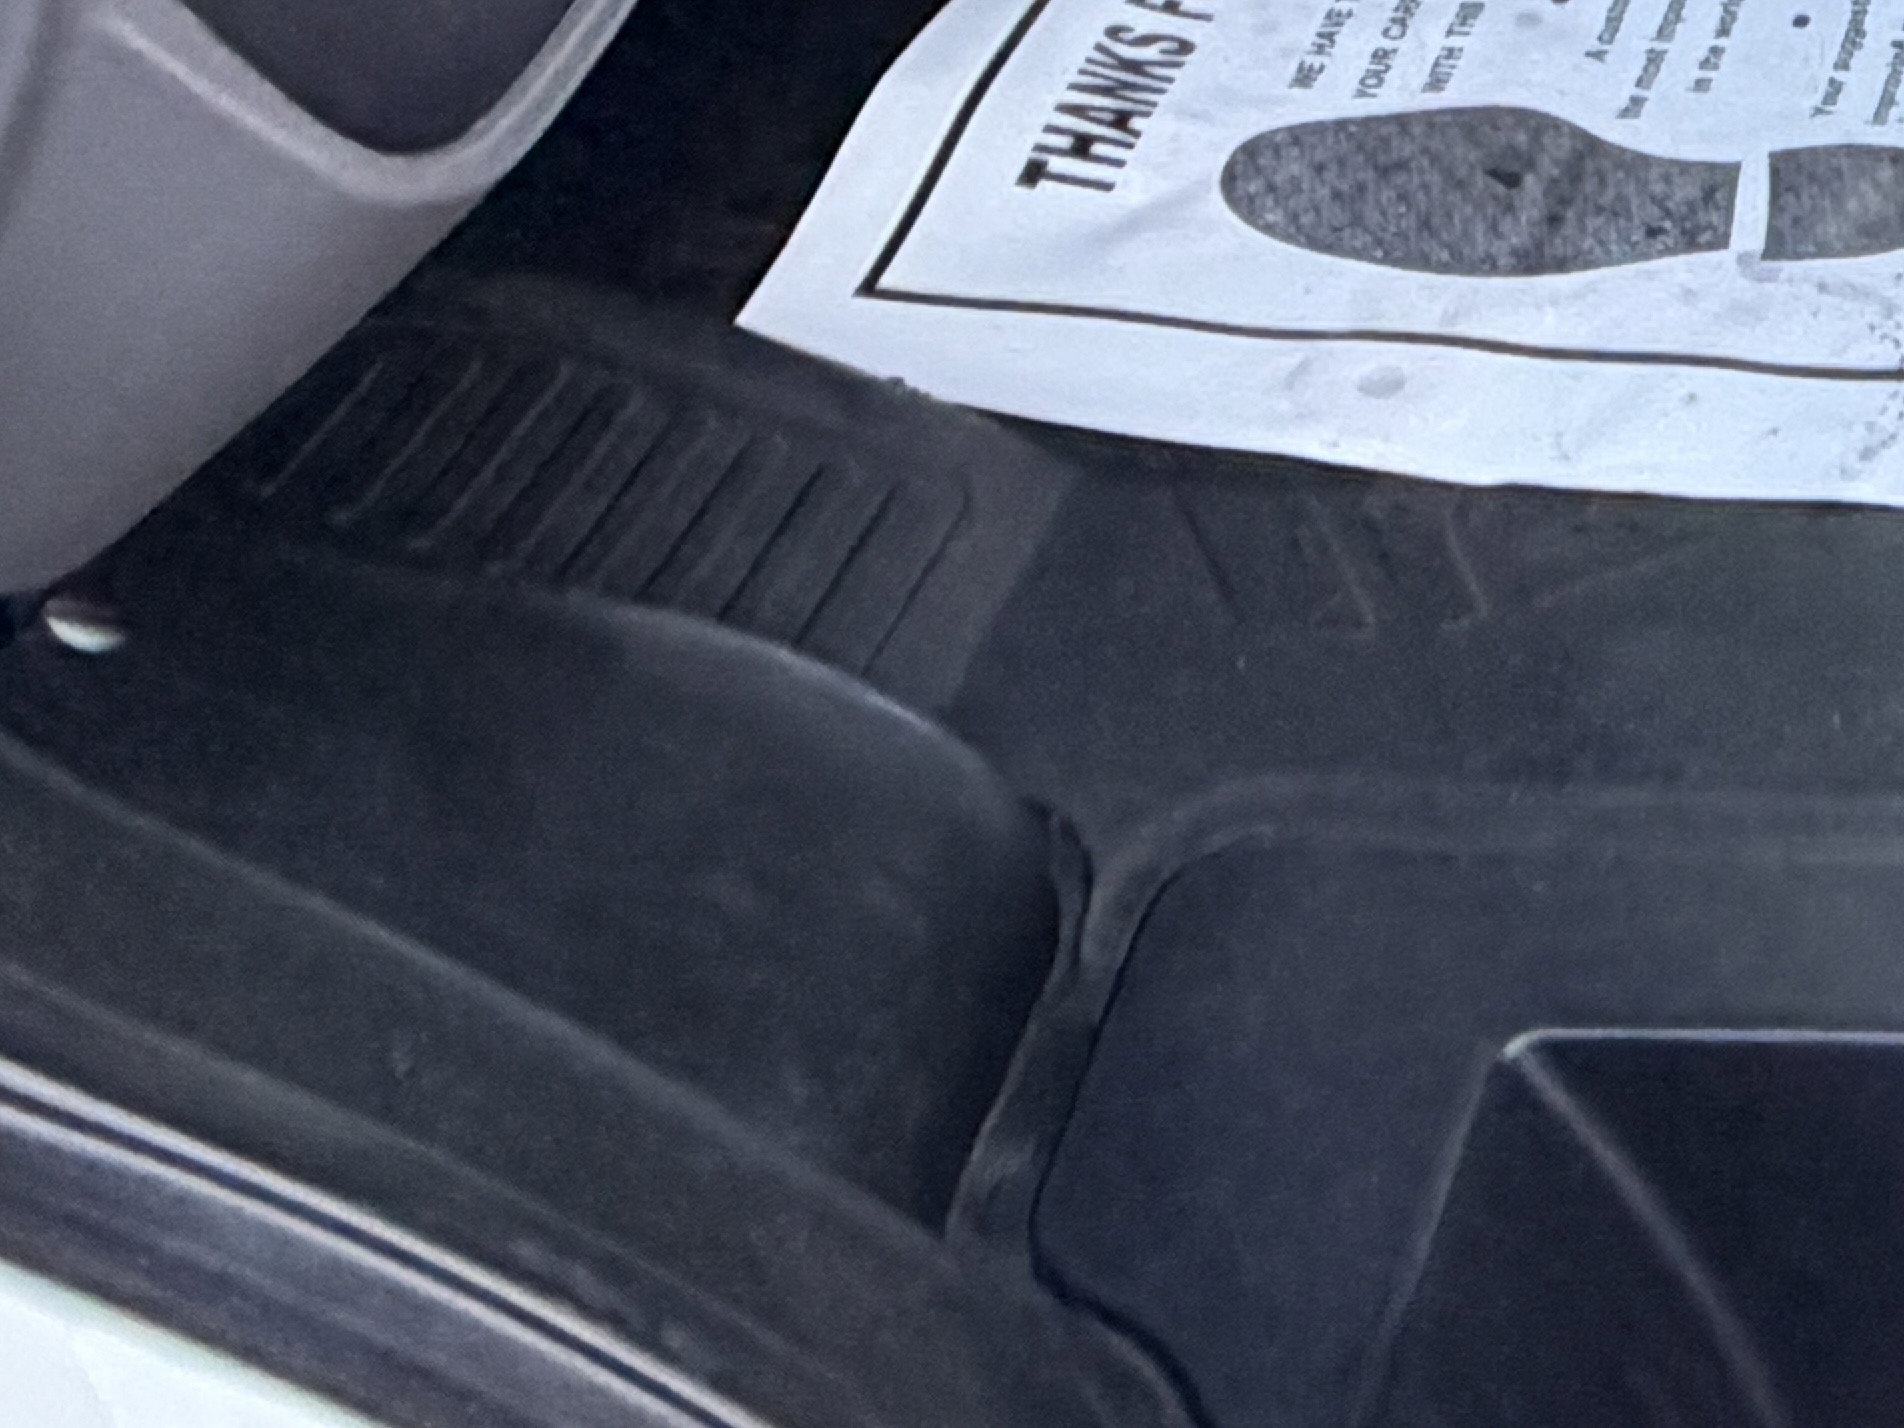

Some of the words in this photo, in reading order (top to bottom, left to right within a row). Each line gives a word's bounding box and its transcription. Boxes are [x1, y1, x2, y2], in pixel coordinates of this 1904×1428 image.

[1306, 6, 1354, 57] HAVE
[1288, 59, 1325, 89] WE
[1353, 46, 1398, 99] YOUR
[1421, 46, 1464, 93] WITH
[1584, 49, 1608, 63] A
[1698, 44, 1726, 72] the
[1616, 95, 1648, 119] the
[1635, 47, 1668, 90] most
[1810, 76, 1844, 118] Your
[1015, 25, 1197, 192] THANKS
